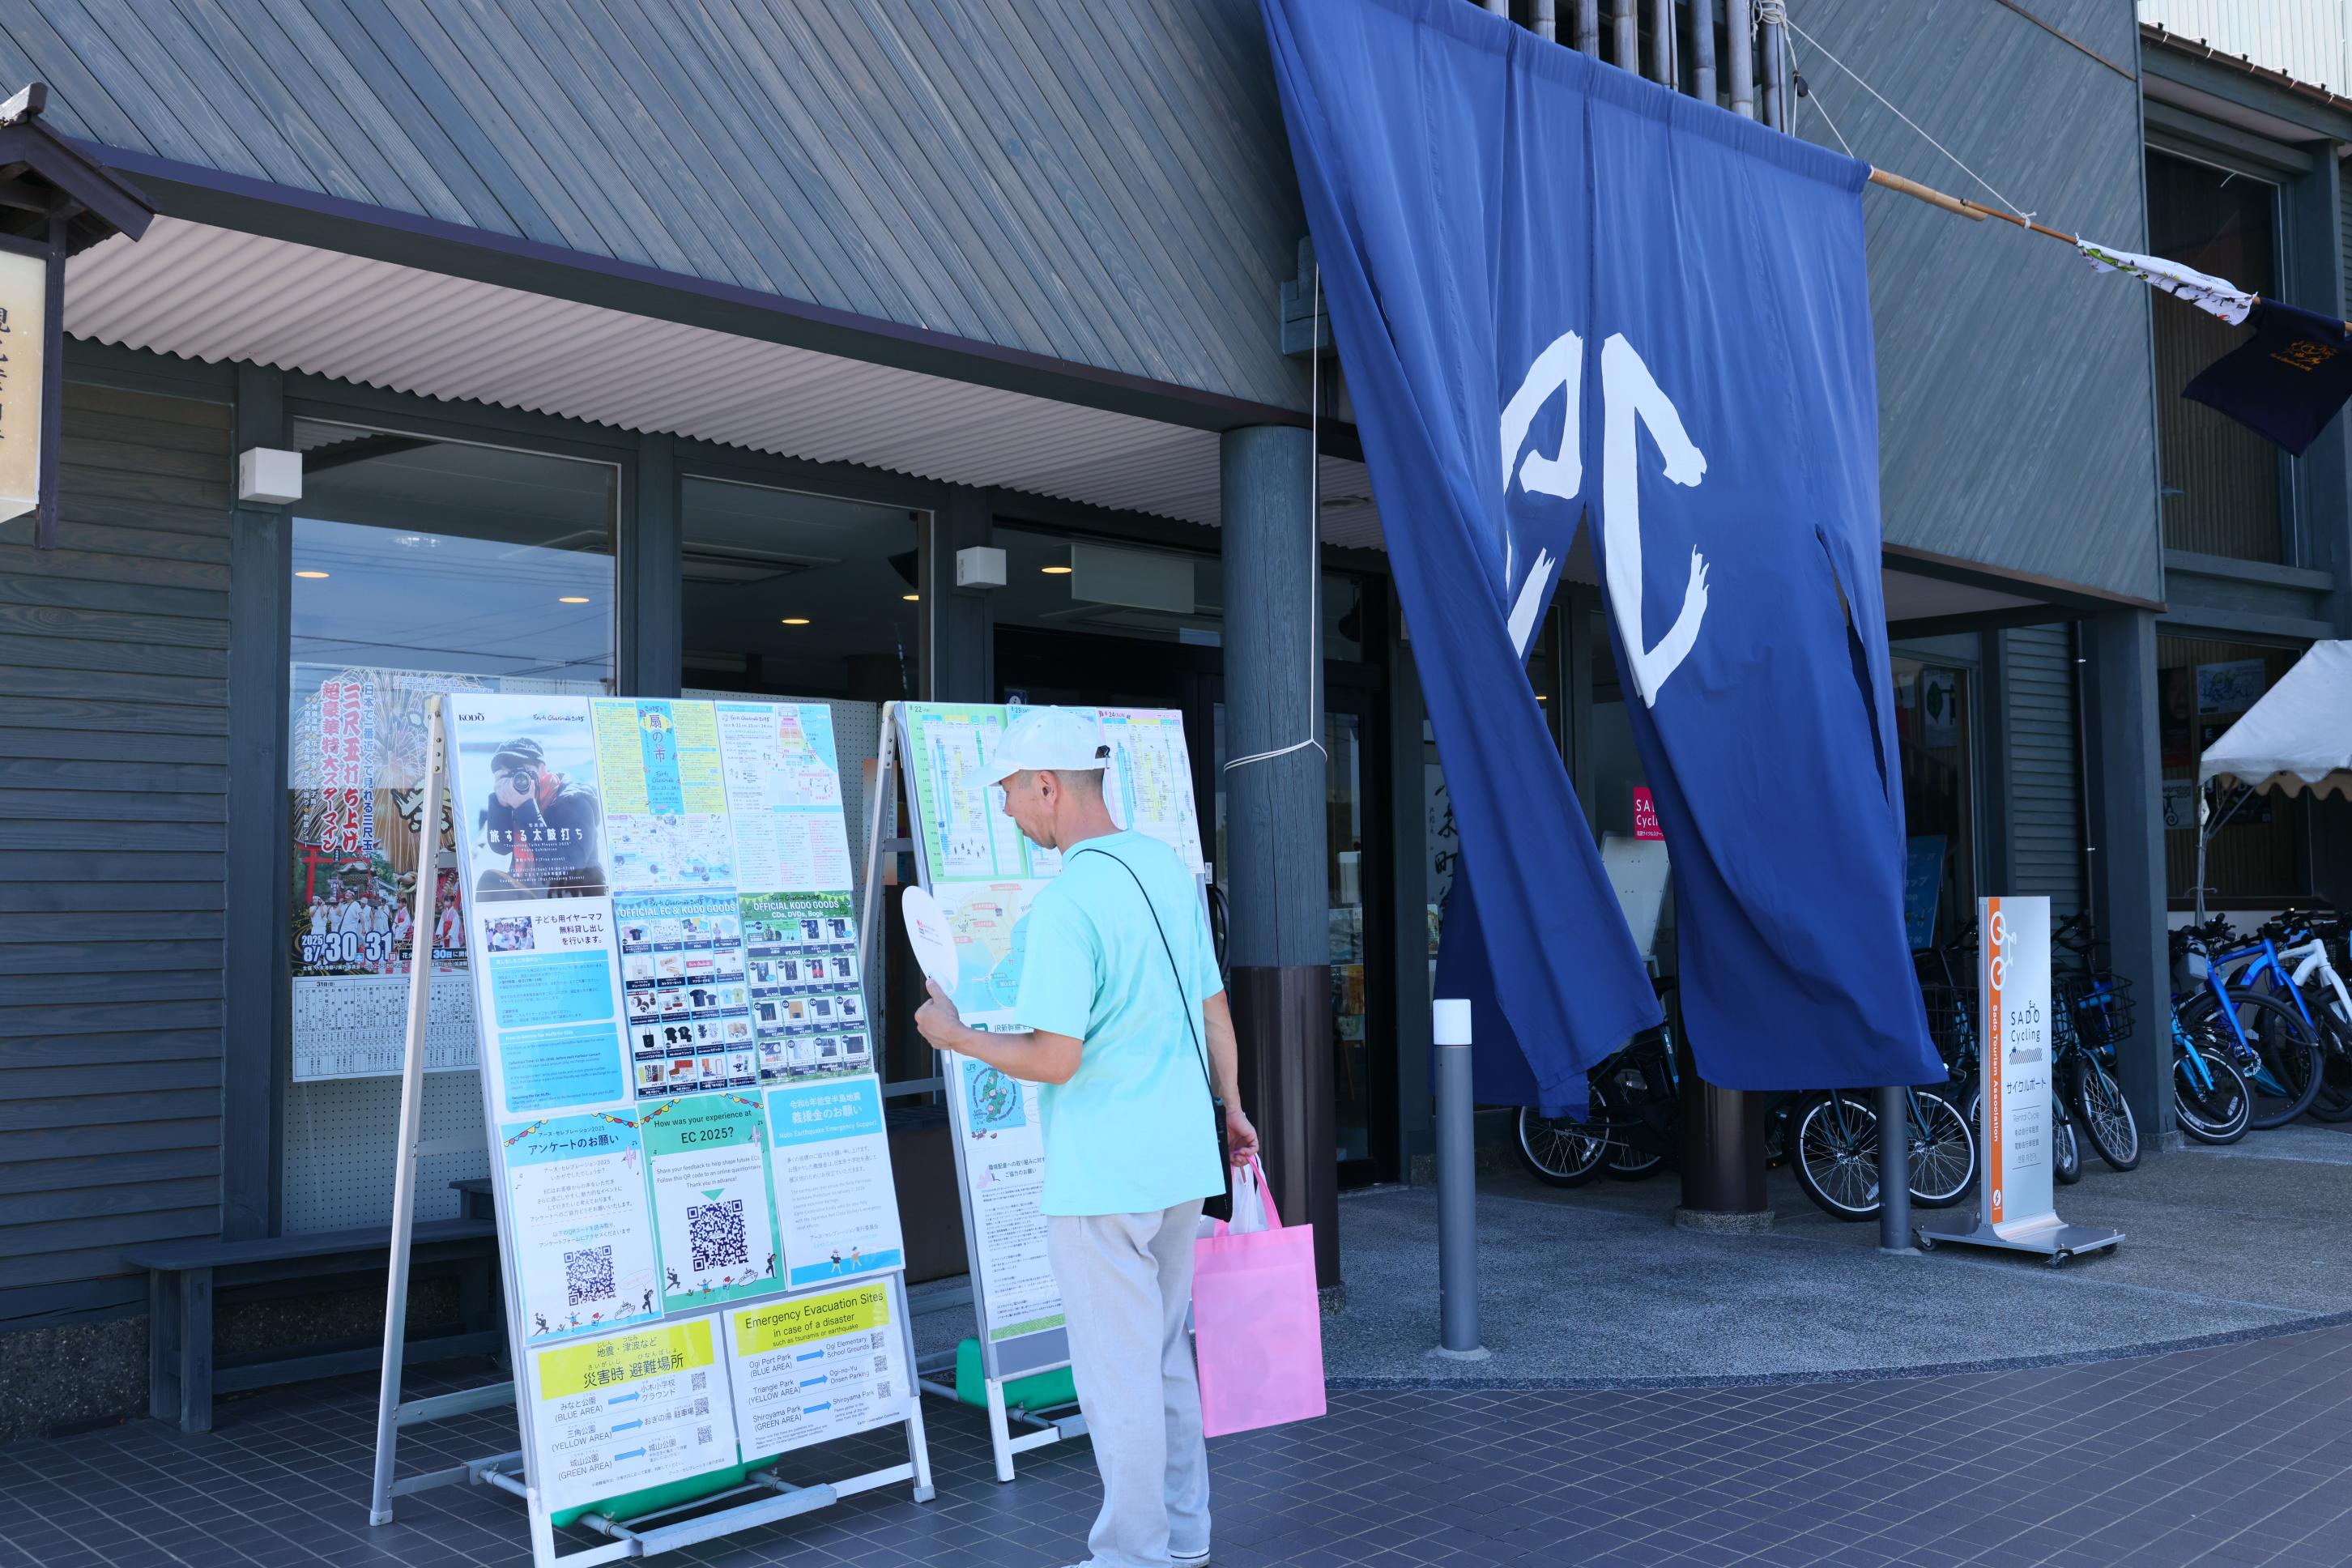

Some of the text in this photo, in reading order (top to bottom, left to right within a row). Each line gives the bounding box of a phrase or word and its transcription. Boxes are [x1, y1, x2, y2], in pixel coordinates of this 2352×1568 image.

[1636, 799, 1655, 812] SA
[1636, 814, 1658, 829] Cycli
[620, 903, 736, 918] OFFICIAL EC & KODO GOODS
[753, 901, 839, 911] OFFICIAL KODO GOODS
[535, 913, 603, 924] 子ども用イヤーマフ
[560, 926, 604, 934] 無料貸し出し
[301, 935, 323, 946] 2025
[561, 935, 603, 945] を行います。
[2010, 1009, 2040, 1025] SADO
[2010, 1029, 2041, 1045] Cycling
[966, 1063, 977, 1072] JR
[790, 1092, 861, 1109] 令和6年能登半島地震
[654, 1119, 671, 1128] How
[672, 1118, 687, 1126] was
[688, 1117, 704, 1127] your
[705, 1112, 744, 1124] experience
[791, 1105, 863, 1124] 義援金のお願い
[2013, 1110, 2040, 1123] Rental Cycle
[681, 1127, 735, 1144] EC 2025?
[794, 1127, 824, 1138] Earthquake
[825, 1124, 855, 1134] Emergency
[855, 1120, 877, 1129] Support
[528, 1134, 619, 1156] アンケートのお願い
[683, 1163, 705, 1171] feedback
[711, 1161, 721, 1169] help
[722, 1159, 736, 1168] shape
[1004, 1168, 1037, 1178] ご協力のお願い
[657, 1176, 672, 1184] Follow
[745, 1291, 884, 1330] Emergency Evacuation Sites
[773, 1328, 782, 1338] in
[783, 1325, 803, 1336] case
[804, 1321, 813, 1331] of
[823, 1312, 855, 1327] disaster
[773, 1339, 786, 1348] such
[795, 1332, 820, 1342] tsunamis
[828, 1323, 859, 1336] earthquake
[825, 1336, 867, 1352] Ogi Elementary
[596, 1336, 658, 1358] 地震・津波など
[827, 1344, 870, 1358] School Grounds
[749, 1353, 791, 1370] Ogi Port Park
[750, 1361, 793, 1378] (BLUE AREA)
[583, 1353, 684, 1389] 災害時 避難場所
[830, 1370, 871, 1384] Onsen Parking
[560, 1378, 676, 1412] みなと公園 小木小学校
[753, 1378, 795, 1395] Triangle Park
[641, 1388, 676, 1403] グラウンド
[748, 1386, 801, 1406] (YELLOW AREA)
[832, 1389, 875, 1406] Shiroyama Park
[555, 1405, 603, 1423] (BLUE AREA)
[752, 1404, 802, 1423] Shiroyama Park
[567, 1425, 596, 1439] 三角公園
[644, 1412, 672, 1425] おぎの湯
[754, 1413, 802, 1433] (GREEN AREA)
[552, 1431, 612, 1453] (YELLOW AREA)
[558, 1467, 587, 1481] (GREEN
[589, 1461, 612, 1473] AREA)
